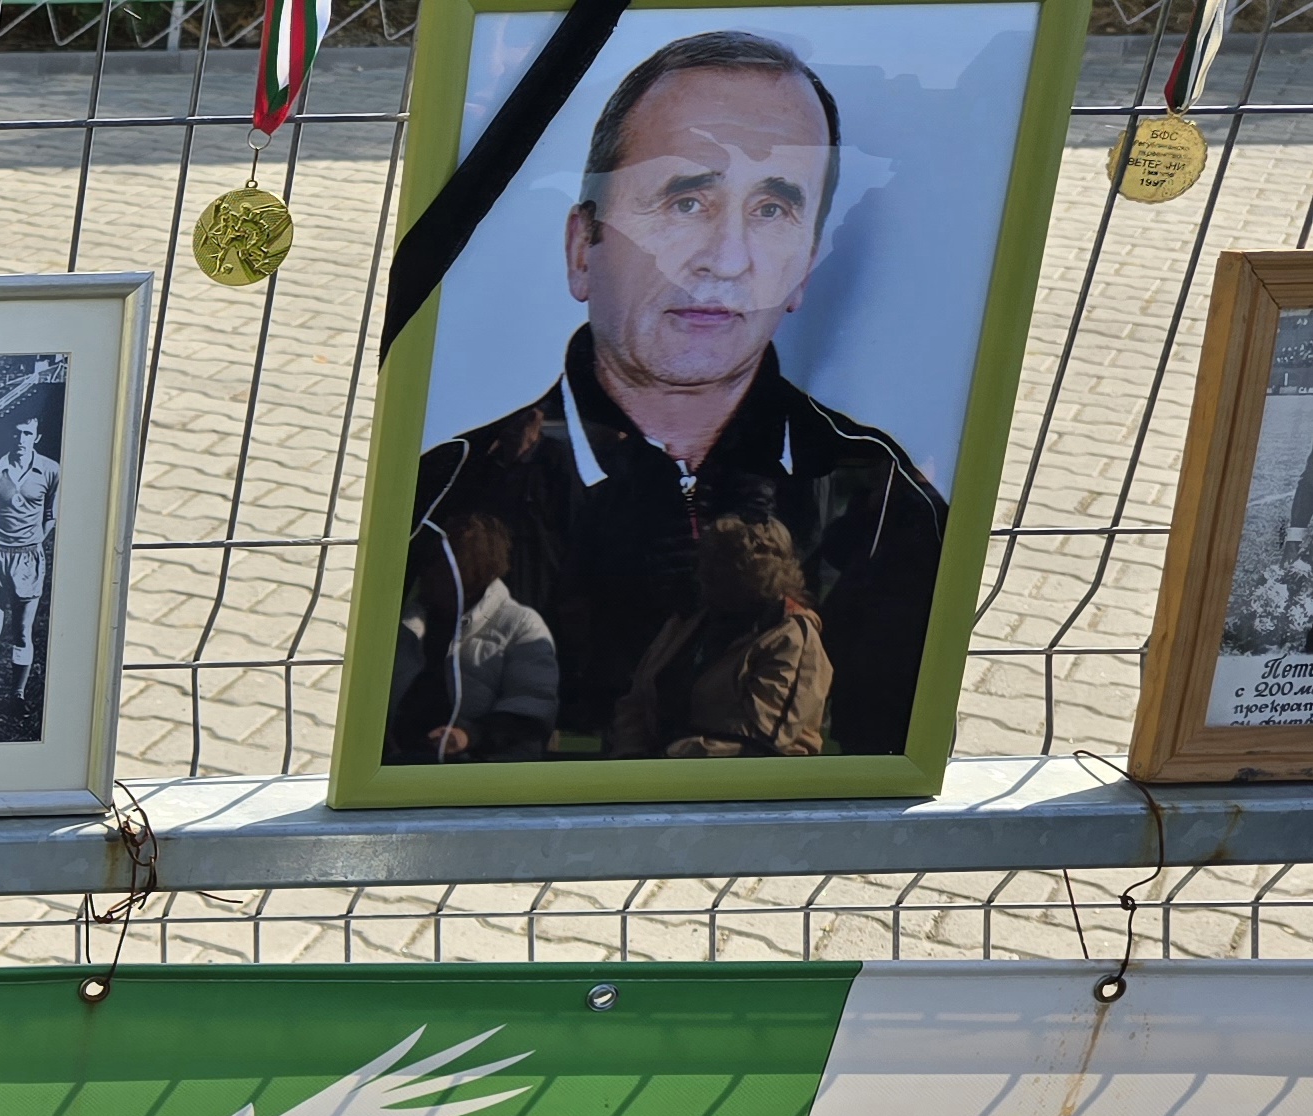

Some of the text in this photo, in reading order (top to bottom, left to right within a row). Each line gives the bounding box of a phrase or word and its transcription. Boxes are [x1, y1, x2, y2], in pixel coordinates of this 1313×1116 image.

[1150, 129, 1179, 141] БФС
[1127, 158, 1186, 171] ВЕТЕРНИ
[1140, 179, 1166, 188] 1997
[1254, 681, 1294, 698] 200
